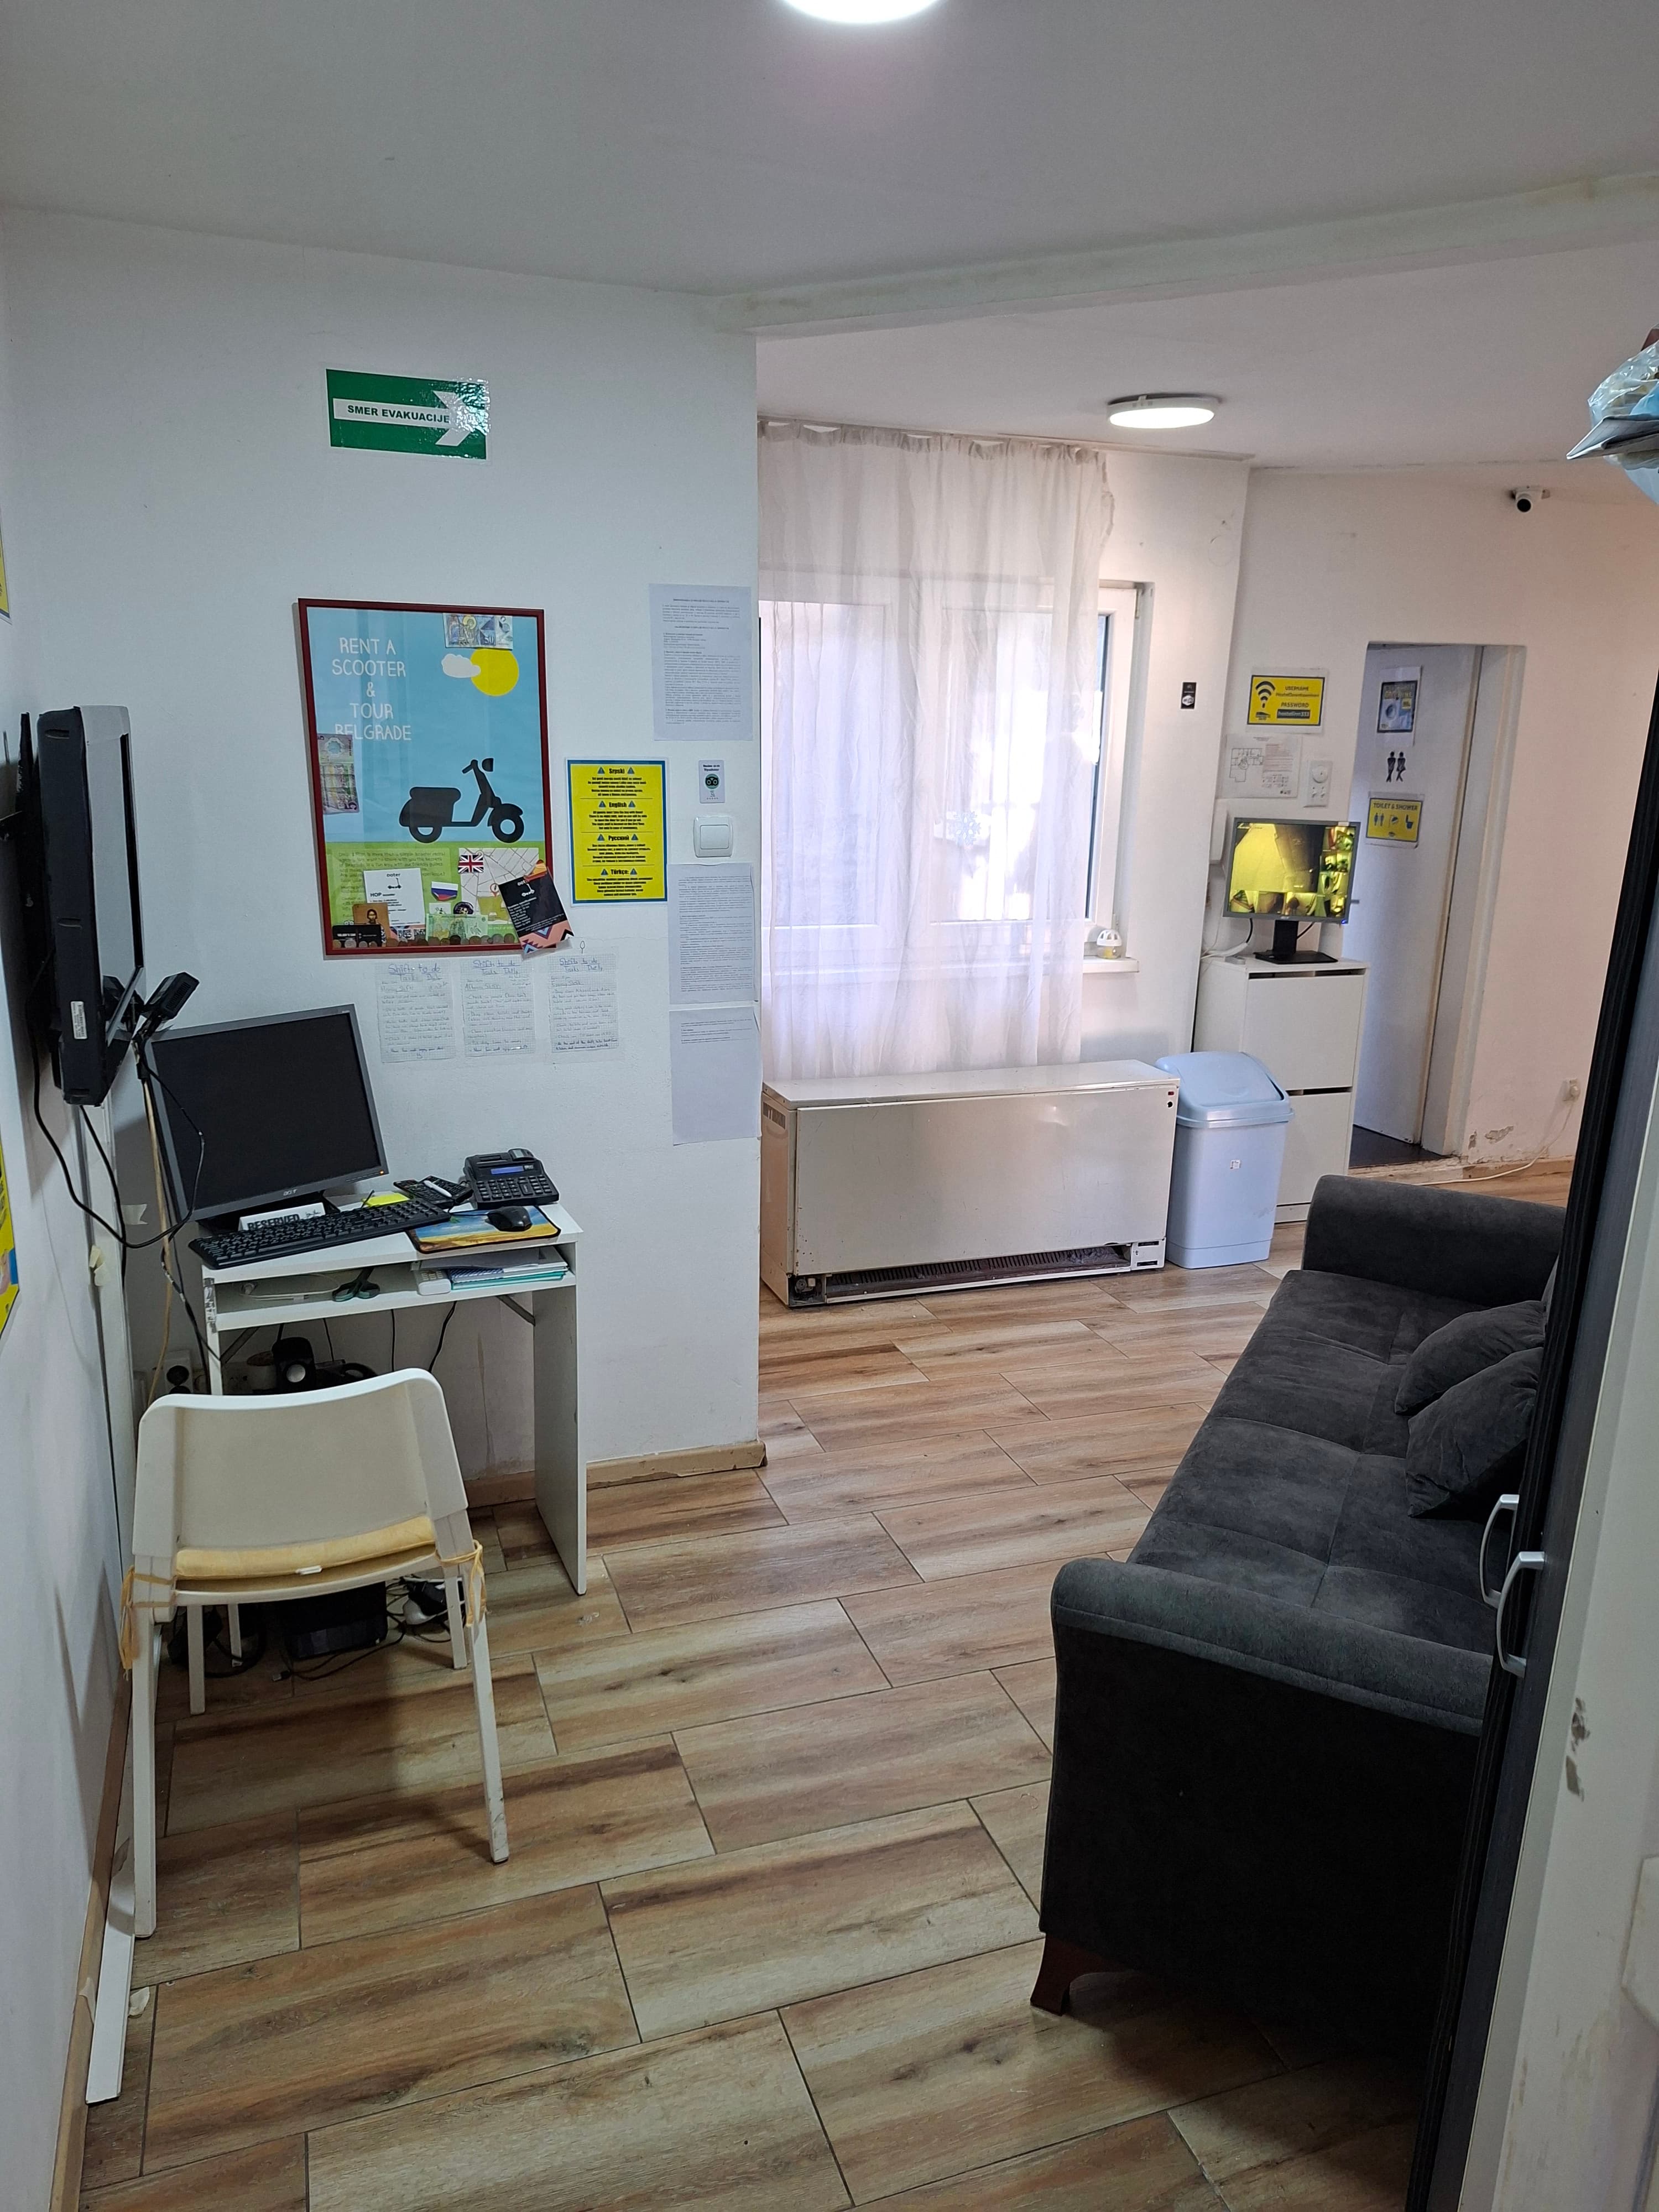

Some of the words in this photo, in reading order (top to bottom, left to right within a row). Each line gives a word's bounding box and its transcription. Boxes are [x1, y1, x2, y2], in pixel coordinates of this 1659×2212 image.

[347, 405, 379, 416] SMER
[382, 409, 450, 423] EVAKUACIJE
[339, 637, 380, 654] RENT
[386, 639, 397, 655] A
[332, 659, 406, 677] SCOOTER
[366, 681, 376, 697] &
[349, 703, 394, 719] TOUR
[247, 1213, 300, 1230] RESERVED
